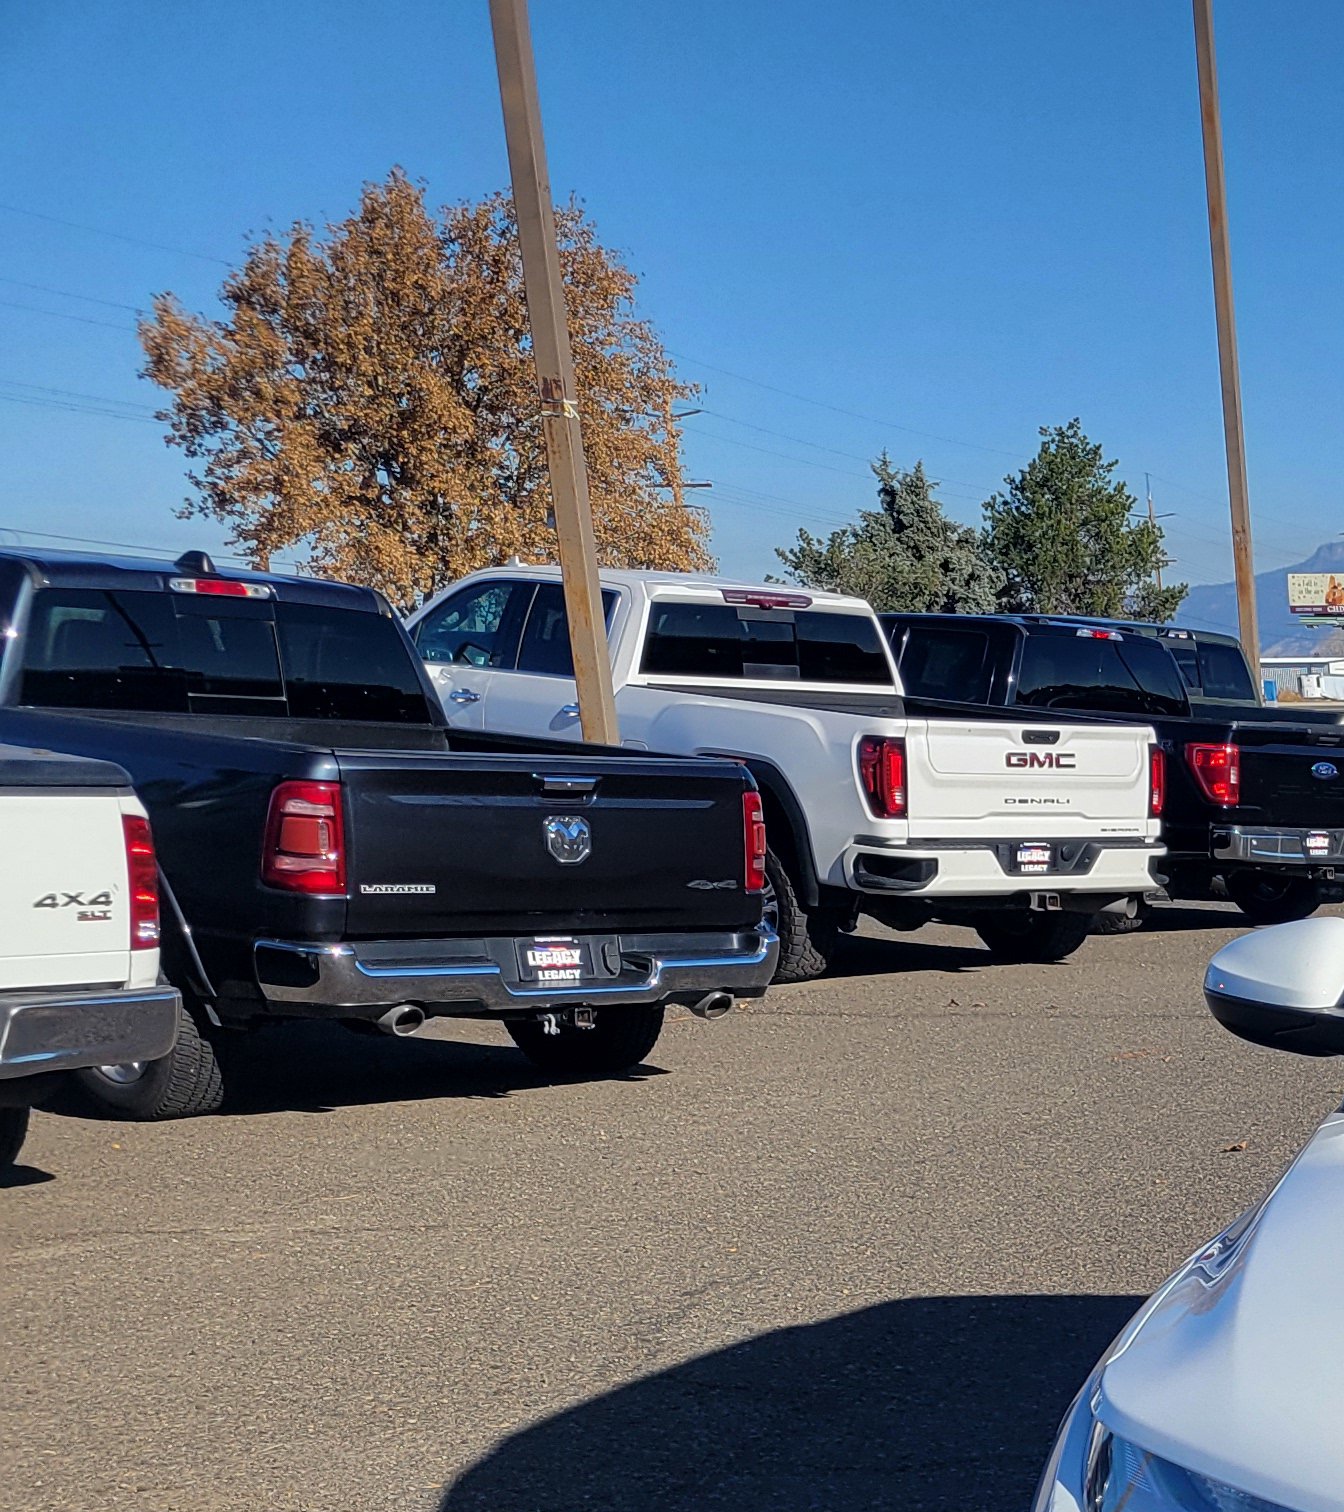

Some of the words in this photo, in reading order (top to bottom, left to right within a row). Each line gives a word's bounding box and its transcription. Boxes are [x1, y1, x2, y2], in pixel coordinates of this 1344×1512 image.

[1005, 752, 1076, 768] GMC
[1016, 850, 1051, 862] LEGACY
[1021, 864, 1048, 872] LEGACY
[361, 885, 436, 893] LARAMIE
[527, 949, 581, 966] LEGACY
[538, 969, 580, 980] LEGACY
